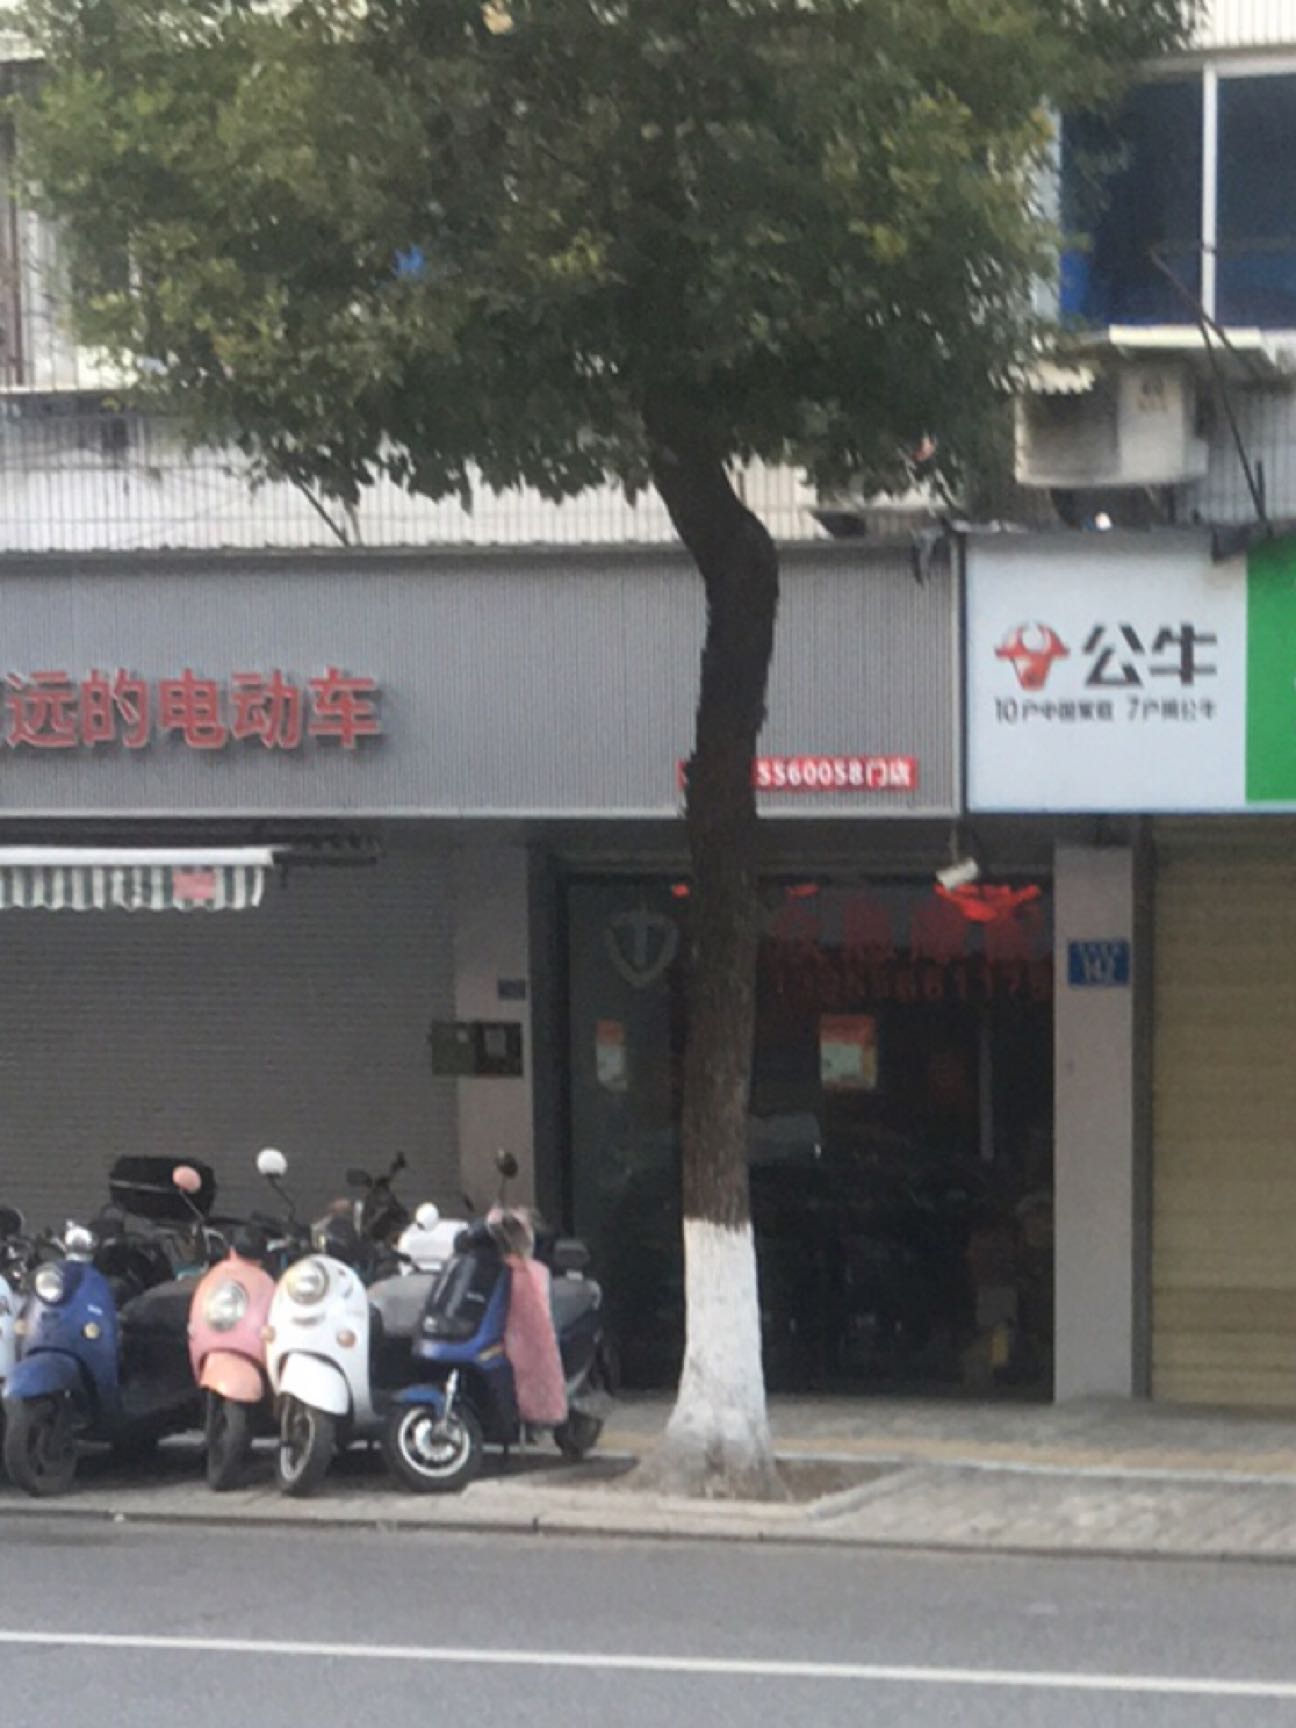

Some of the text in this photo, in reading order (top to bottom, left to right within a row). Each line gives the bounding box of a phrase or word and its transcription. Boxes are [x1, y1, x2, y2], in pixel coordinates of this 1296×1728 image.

[1081, 620, 1218, 688] 公牛
[7, 666, 384, 750] 远的电动车
